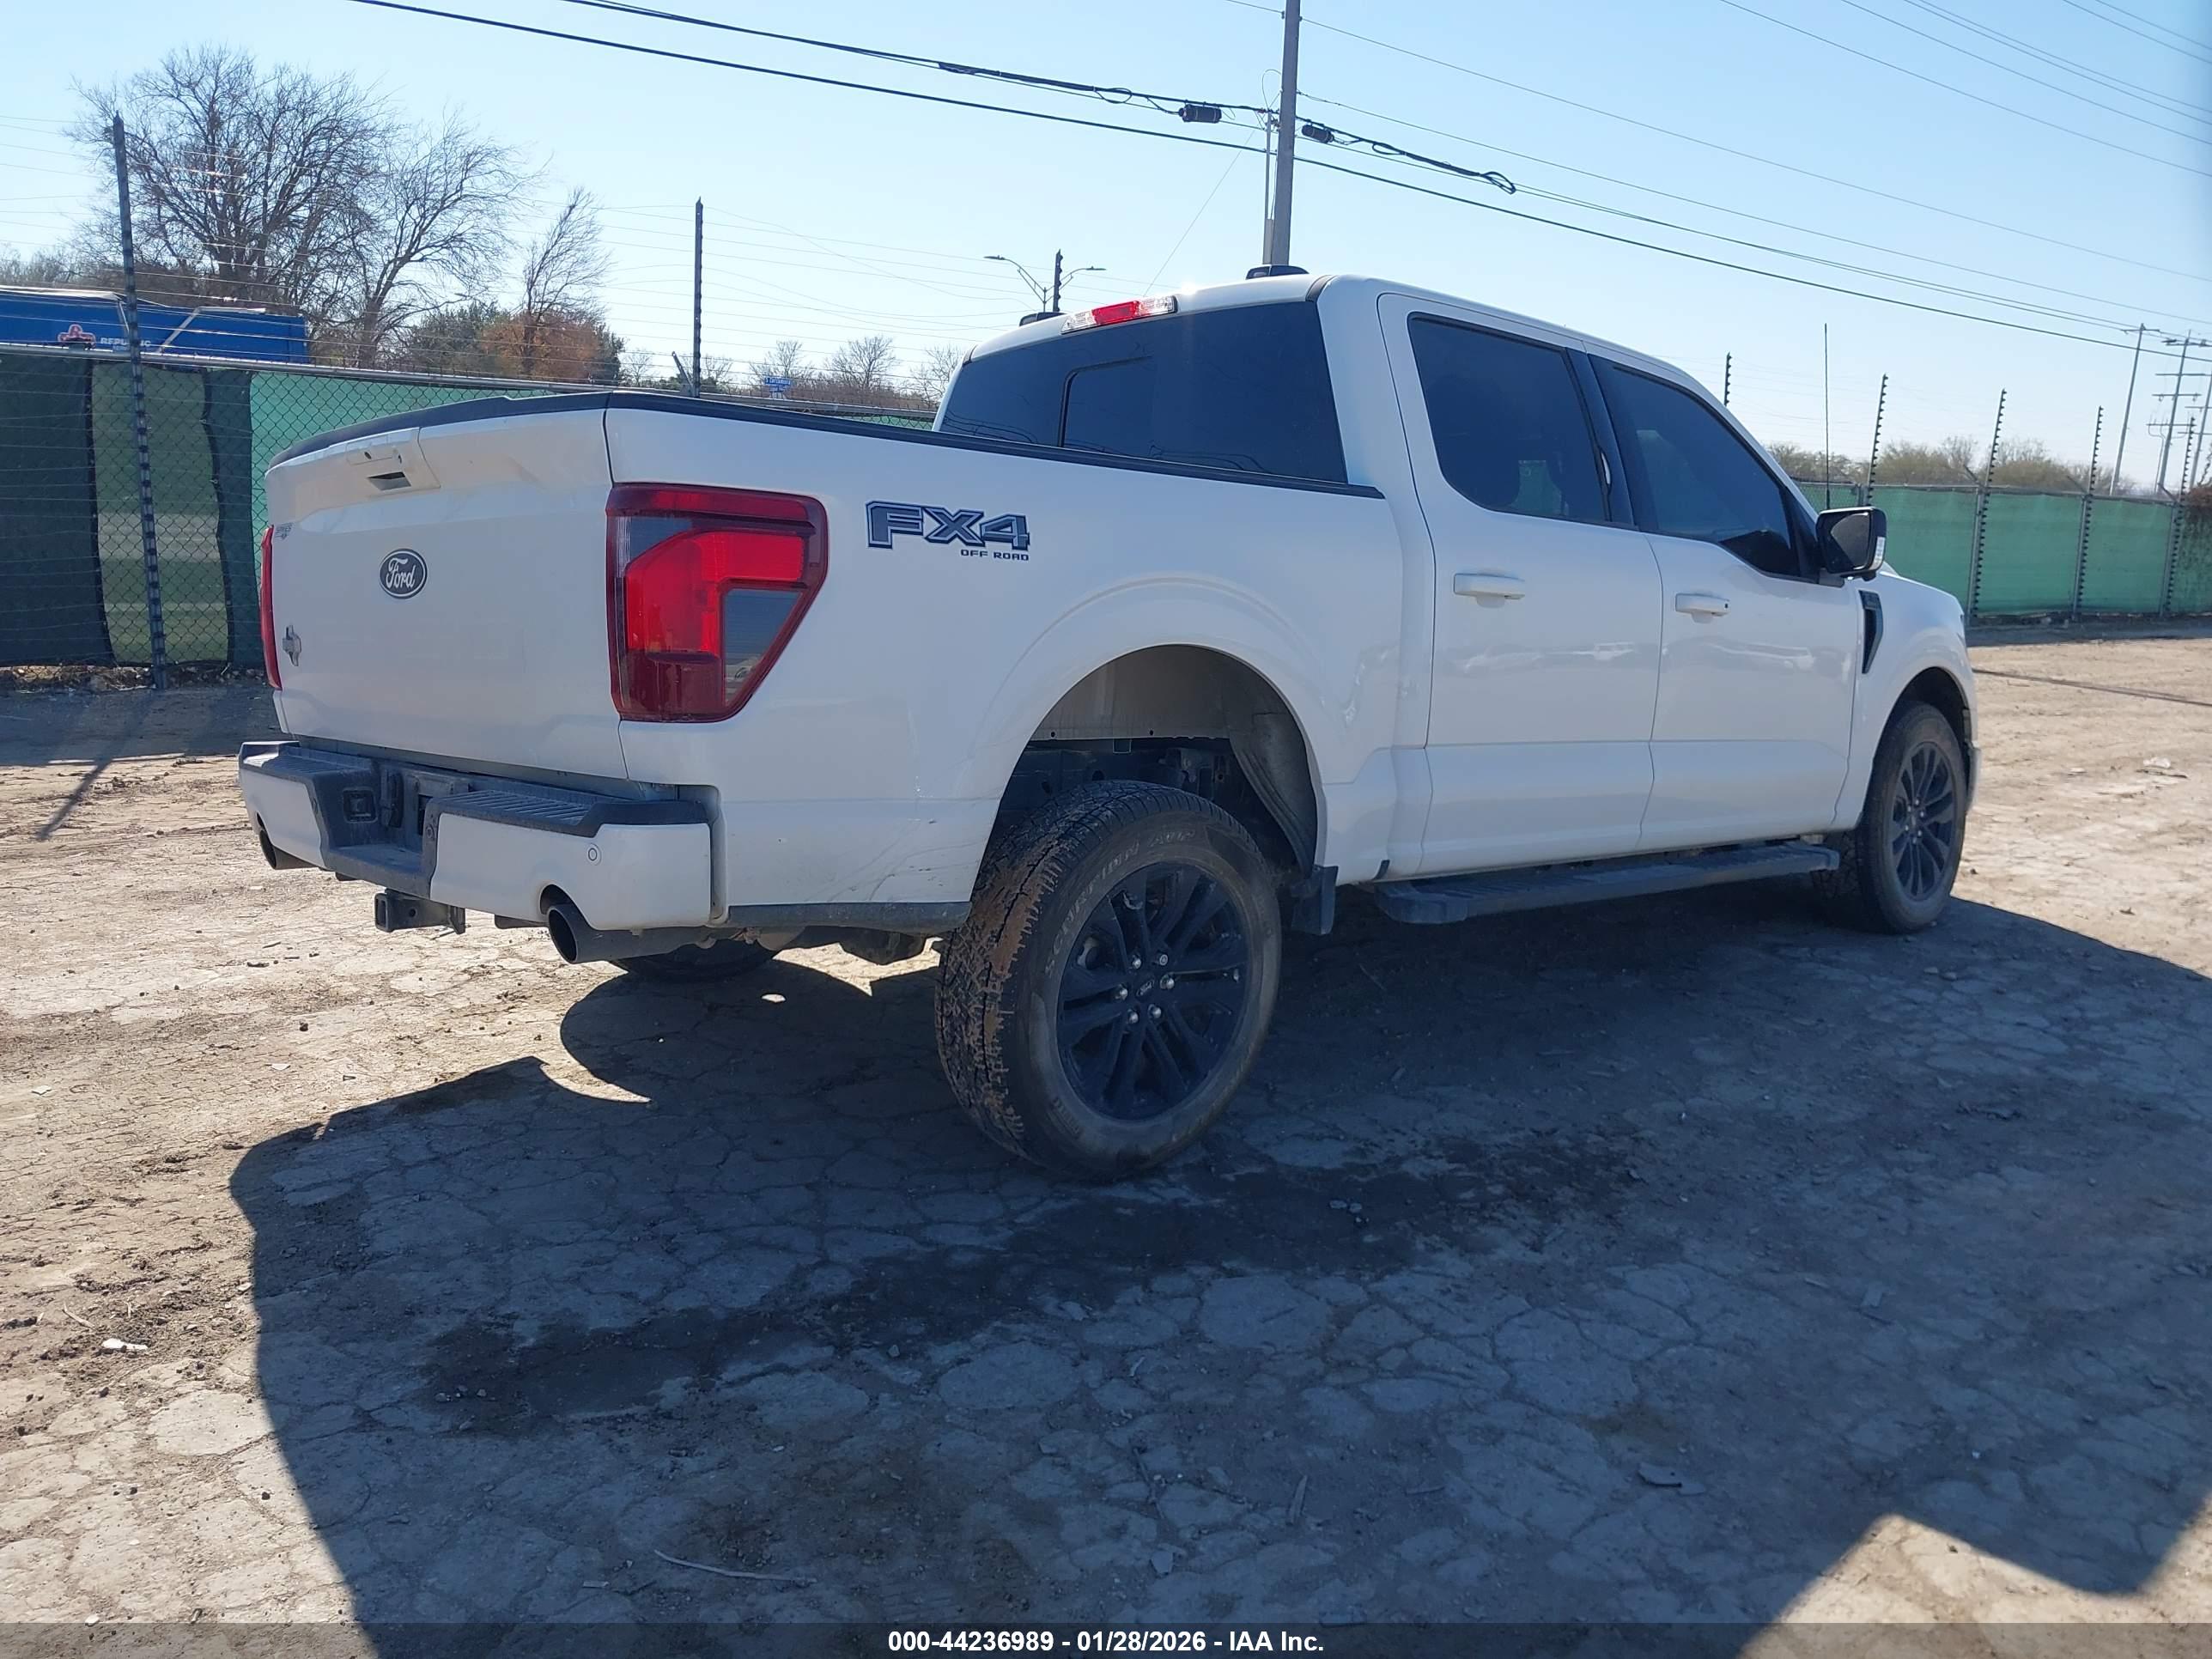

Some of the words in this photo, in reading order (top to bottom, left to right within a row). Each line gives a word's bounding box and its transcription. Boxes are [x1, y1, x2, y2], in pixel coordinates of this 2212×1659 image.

[100, 337, 152, 347] REPUIC
[866, 501, 1030, 551] FX4
[960, 549, 988, 558] OFF
[993, 551, 1030, 562] ROAD
[386, 557, 416, 589] Ford
